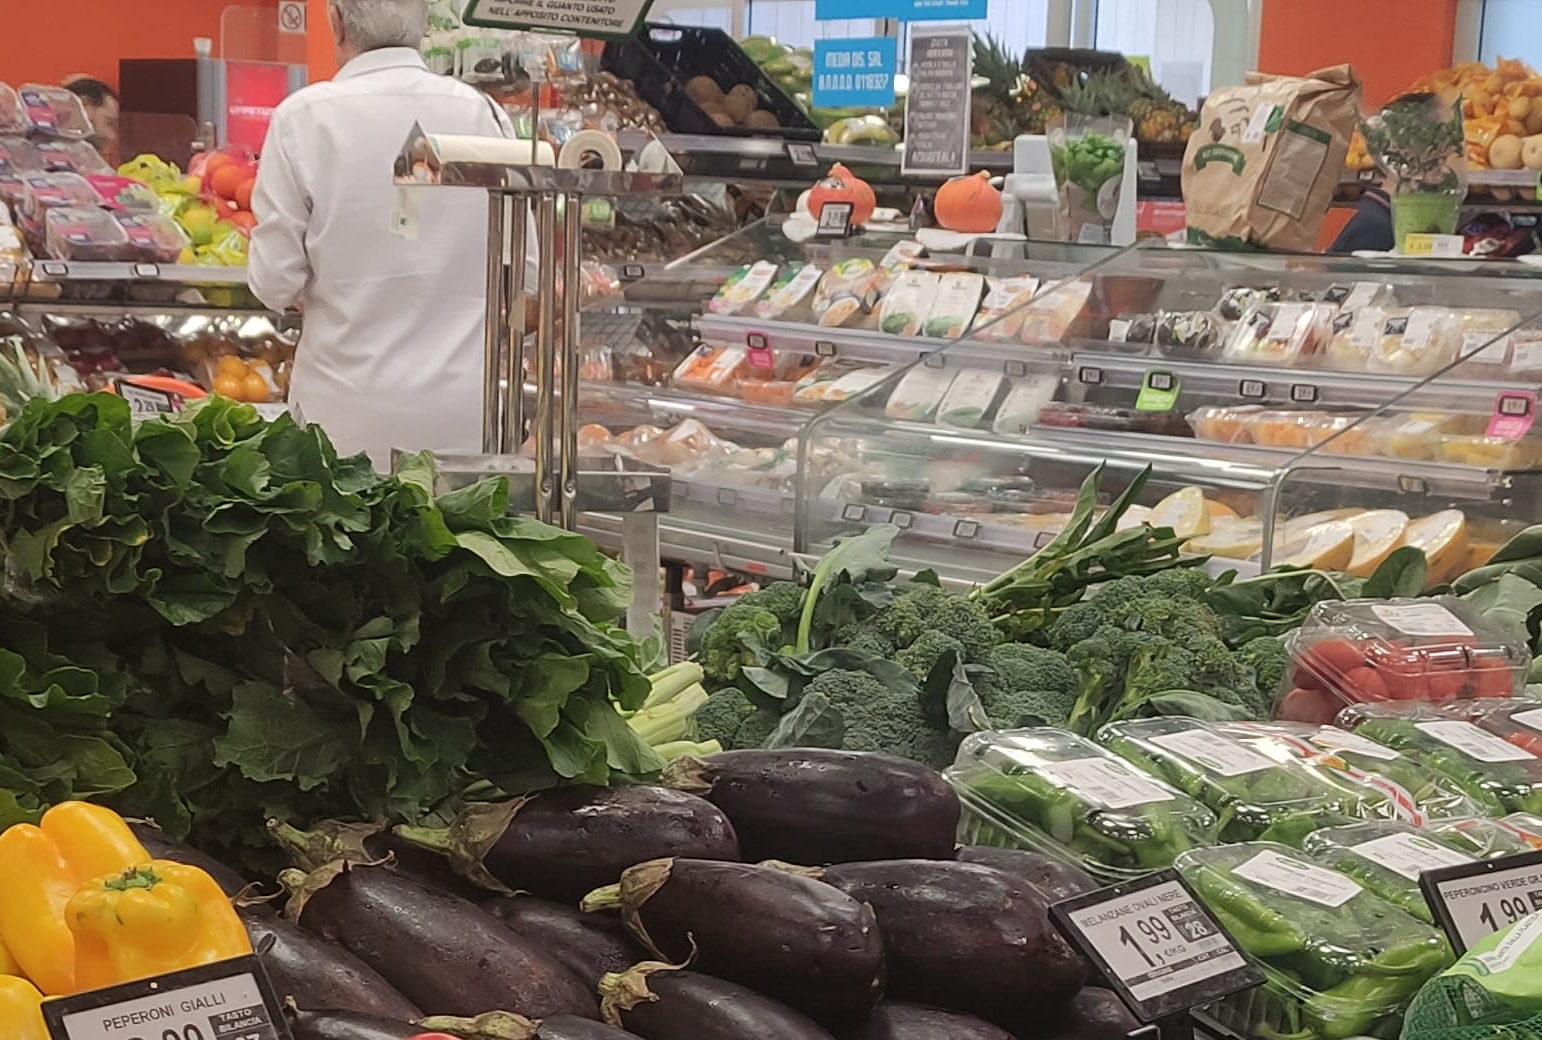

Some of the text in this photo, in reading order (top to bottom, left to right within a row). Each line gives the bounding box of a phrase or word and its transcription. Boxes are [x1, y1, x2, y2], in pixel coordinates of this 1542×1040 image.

[546, 2, 585, 13] GUANTO
[586, 5, 616, 15] USATO
[560, 14, 625, 28] CONTENITORE
[1499, 876, 1528, 890] VERDE
[1079, 904, 1136, 929] MELANZANE
[1157, 888, 1184, 904] NERE
[1184, 919, 1209, 939] 28
[1118, 915, 1172, 969] 1,99
[102, 992, 226, 1033] PEPERONI GIALLI
[219, 1008, 252, 1022] TASTO
[218, 1016, 263, 1034] BILANCIA
